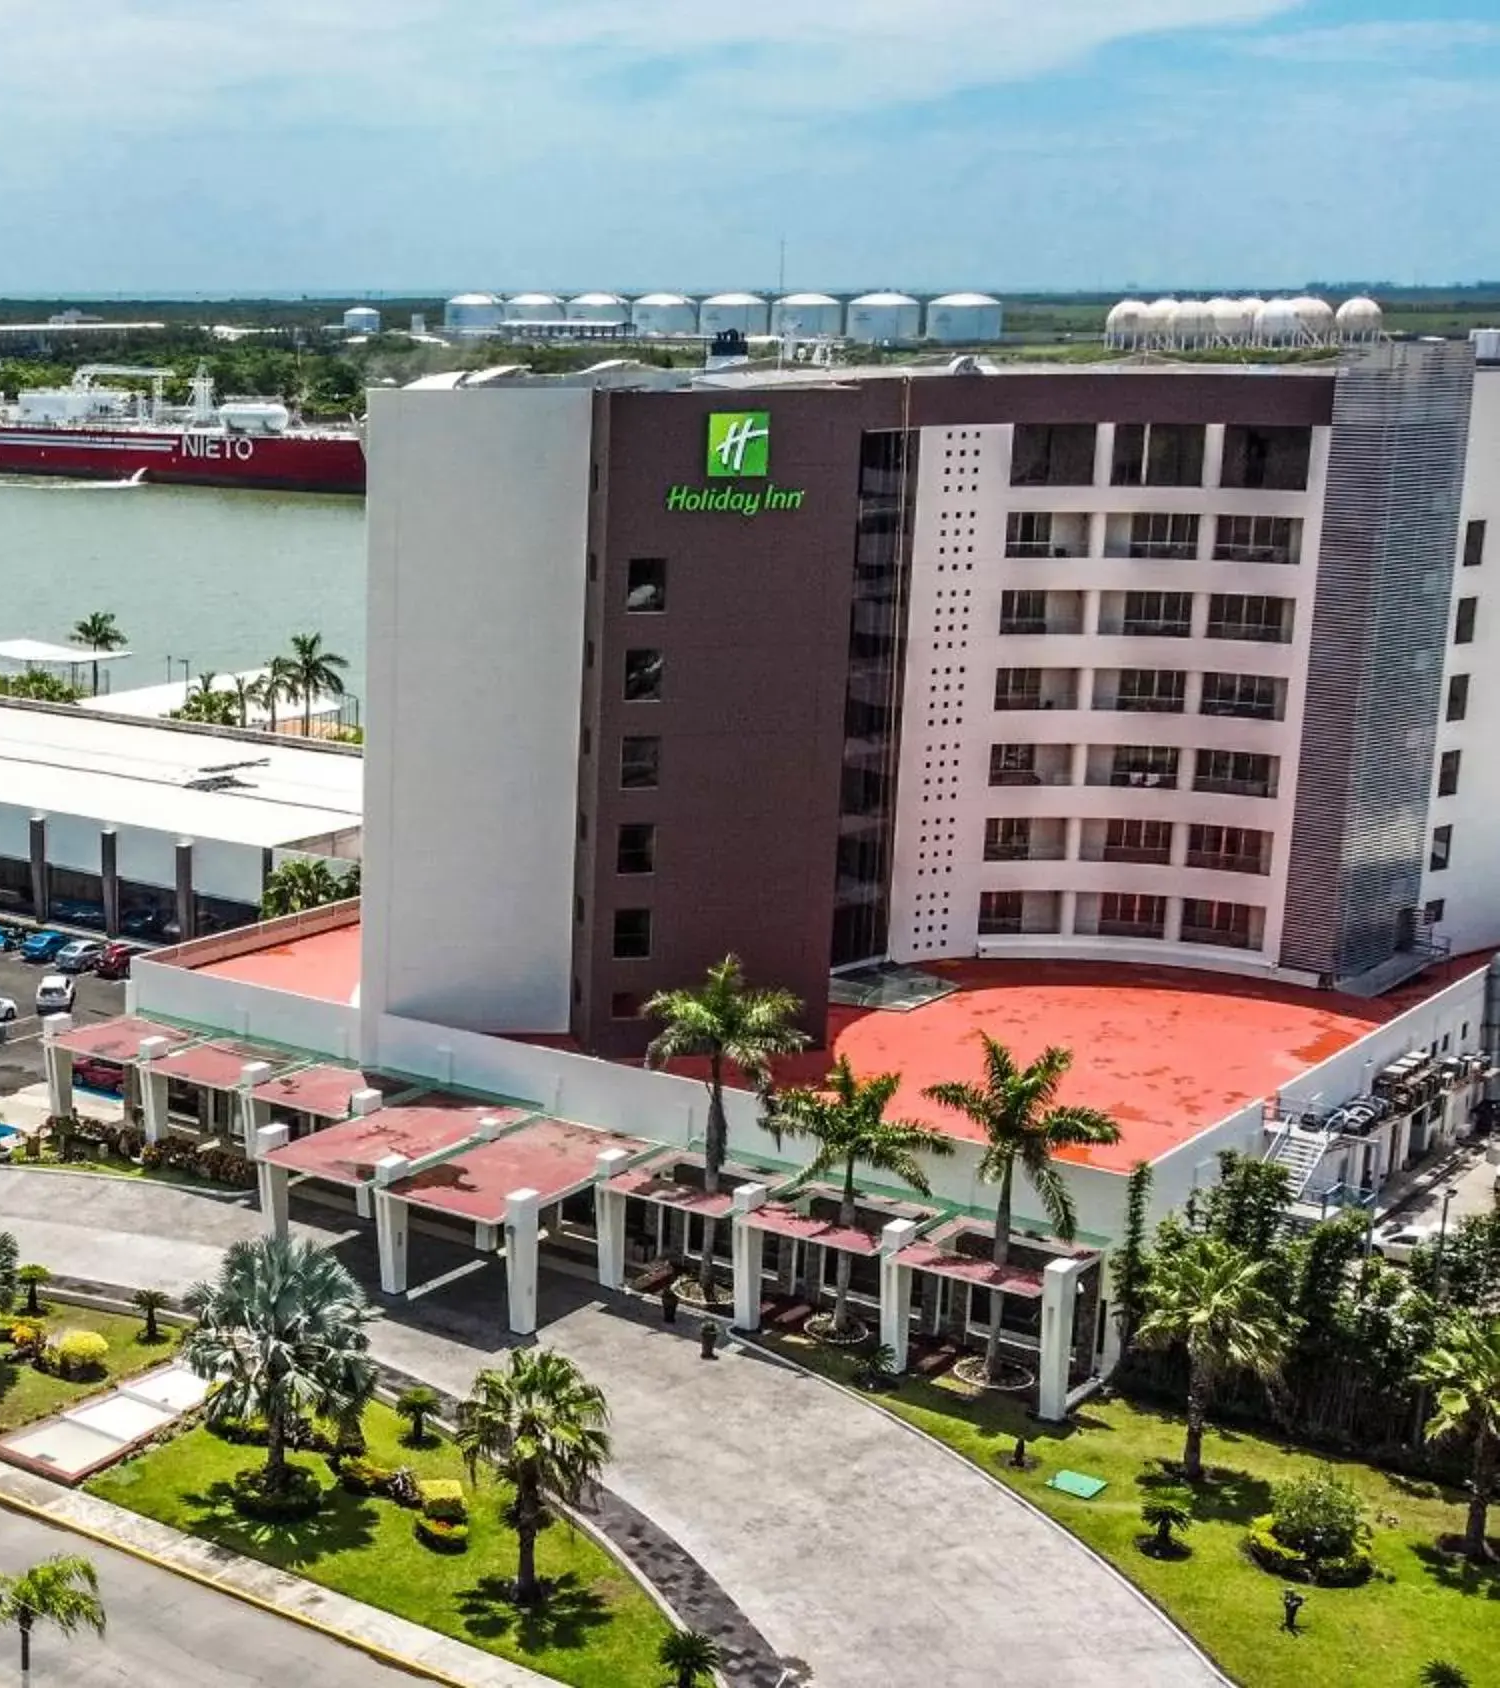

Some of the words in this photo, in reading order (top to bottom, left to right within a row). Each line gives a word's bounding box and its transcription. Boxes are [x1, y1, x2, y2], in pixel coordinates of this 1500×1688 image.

[181, 434, 253, 460] NIETO
[667, 485, 761, 516] Holiday
[763, 483, 802, 509] Inn
